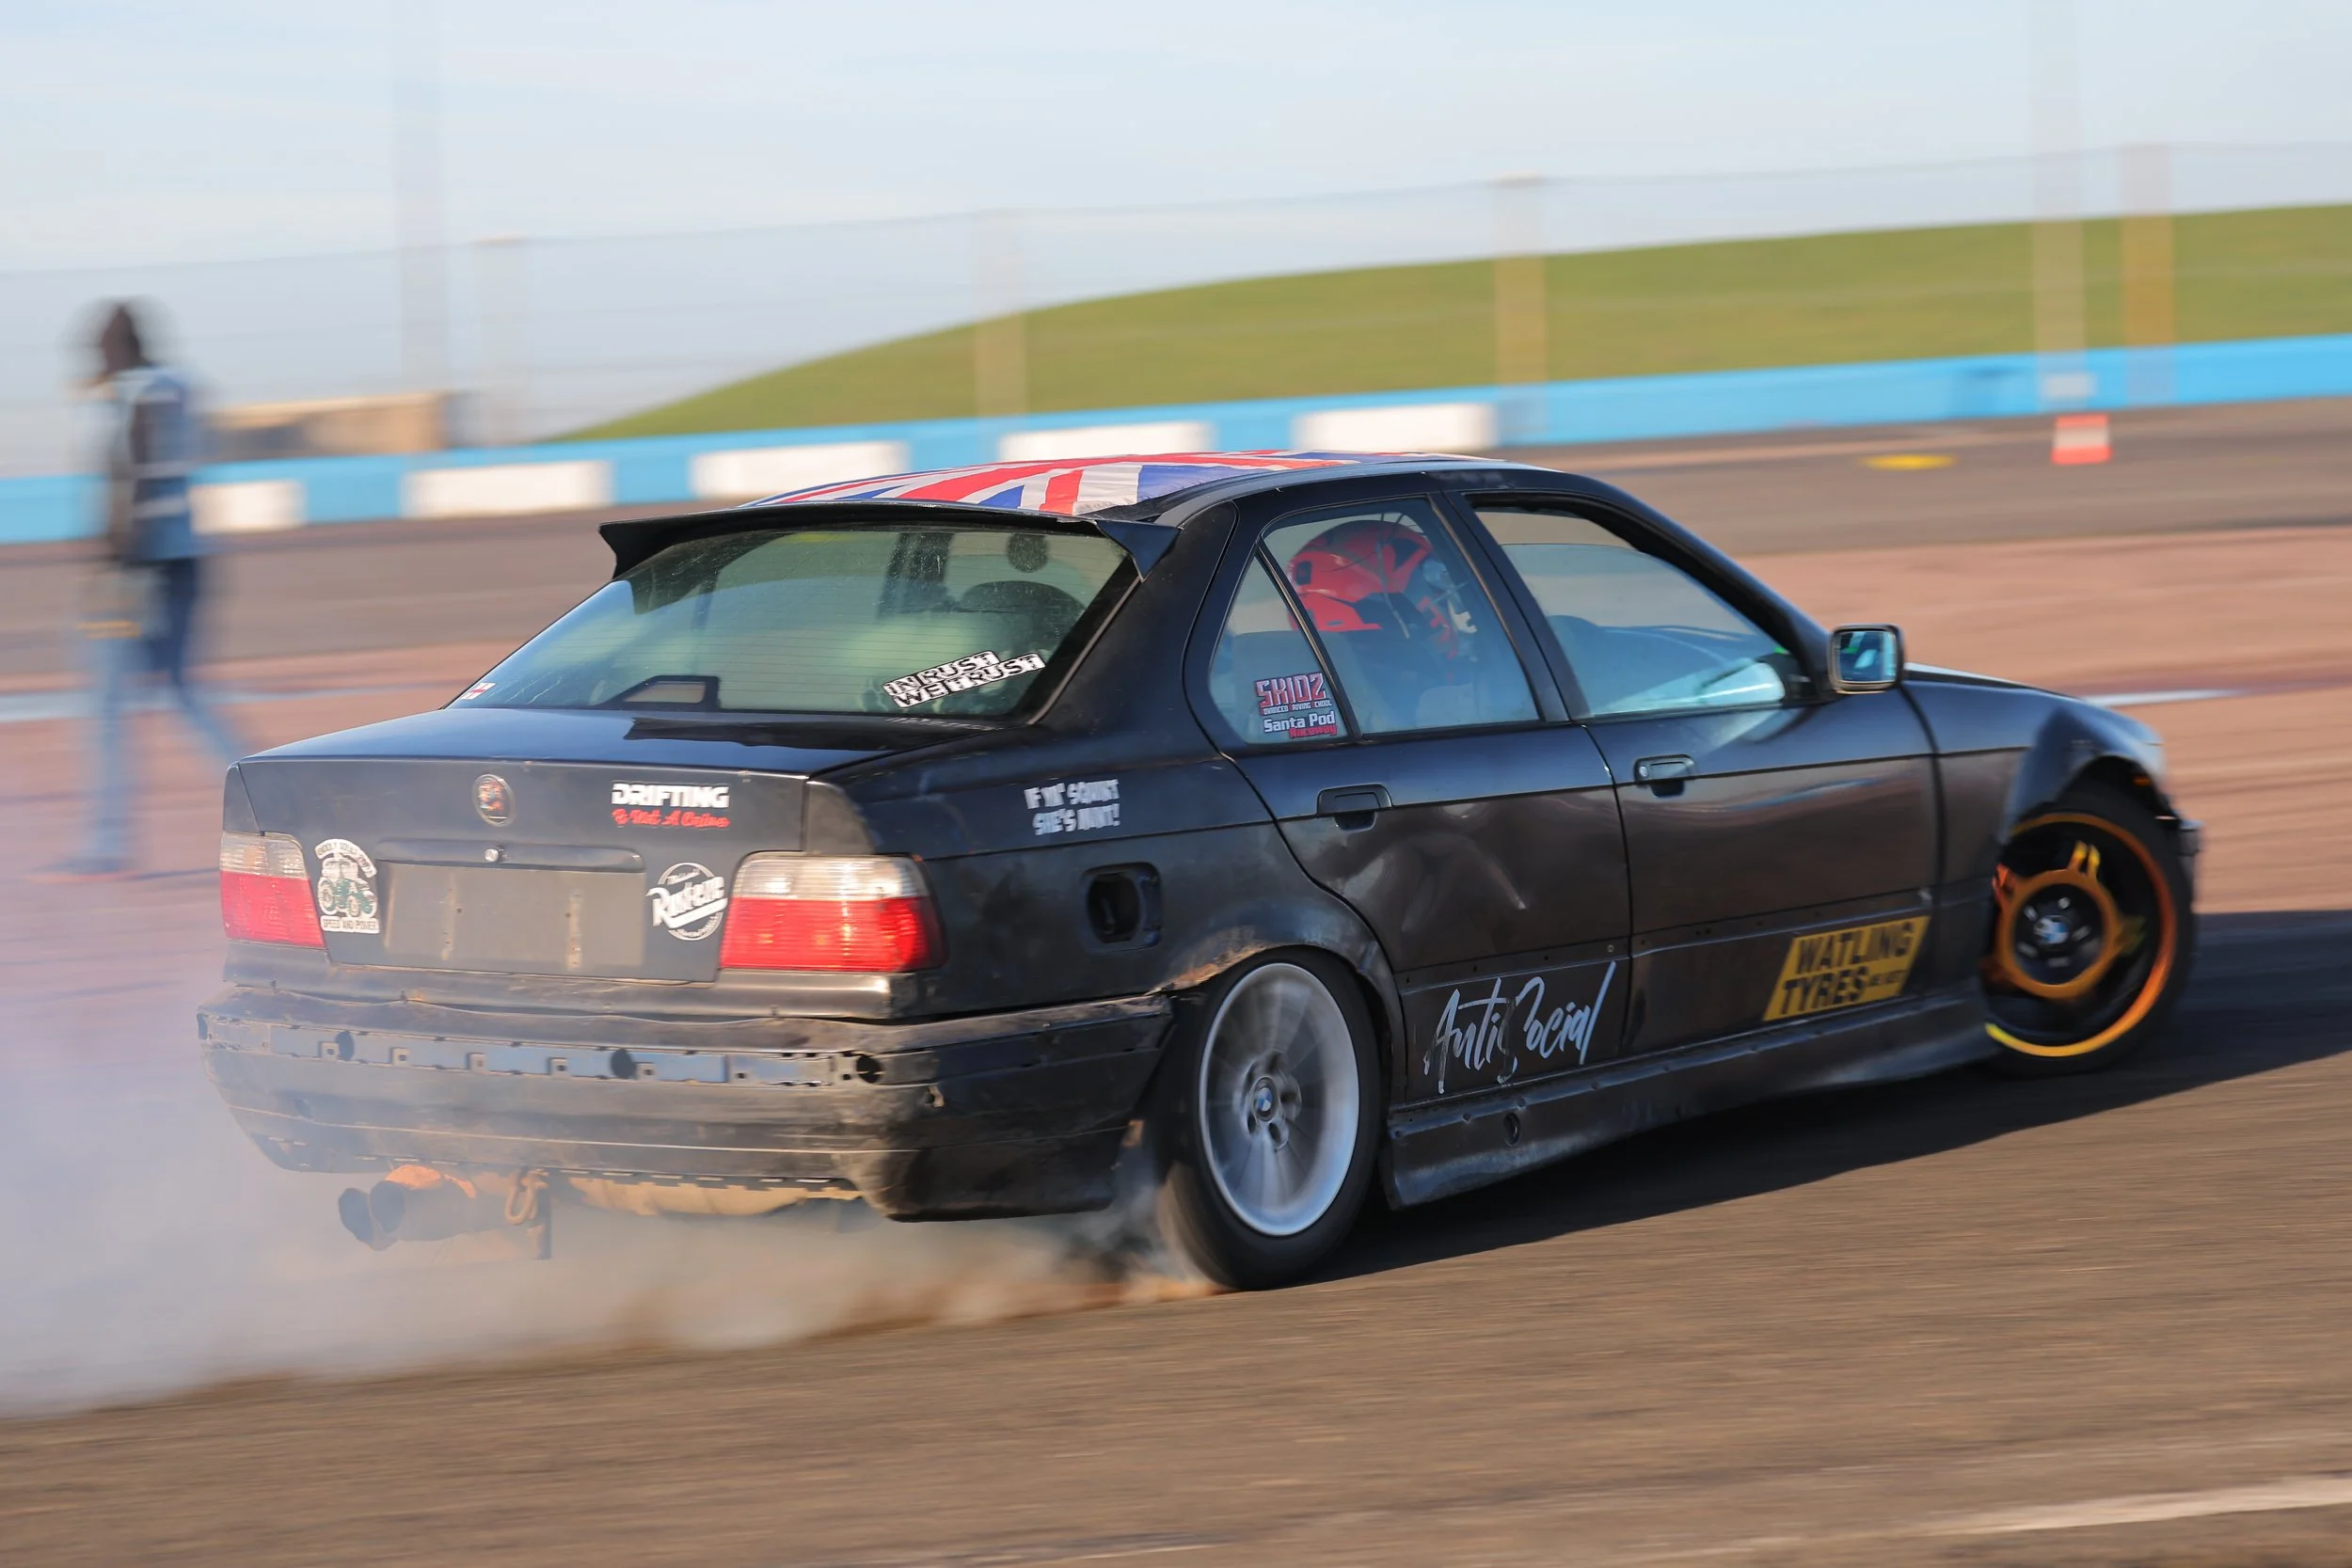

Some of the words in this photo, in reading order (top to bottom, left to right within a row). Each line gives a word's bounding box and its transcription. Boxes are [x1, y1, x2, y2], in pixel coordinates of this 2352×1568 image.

[884, 675, 920, 697] IN
[918, 651, 996, 686] RUST
[897, 682, 946, 705] WE
[946, 654, 1041, 691] TRUST
[1255, 673, 1326, 708] SKIDZ
[1263, 717, 1306, 733] Santa
[1309, 710, 1336, 727] Pod
[1289, 723, 1338, 738] Raceway
[612, 784, 730, 808] DRIFTING
[1796, 922, 1914, 974] WATLING
[1780, 965, 1868, 1016] TYRES
